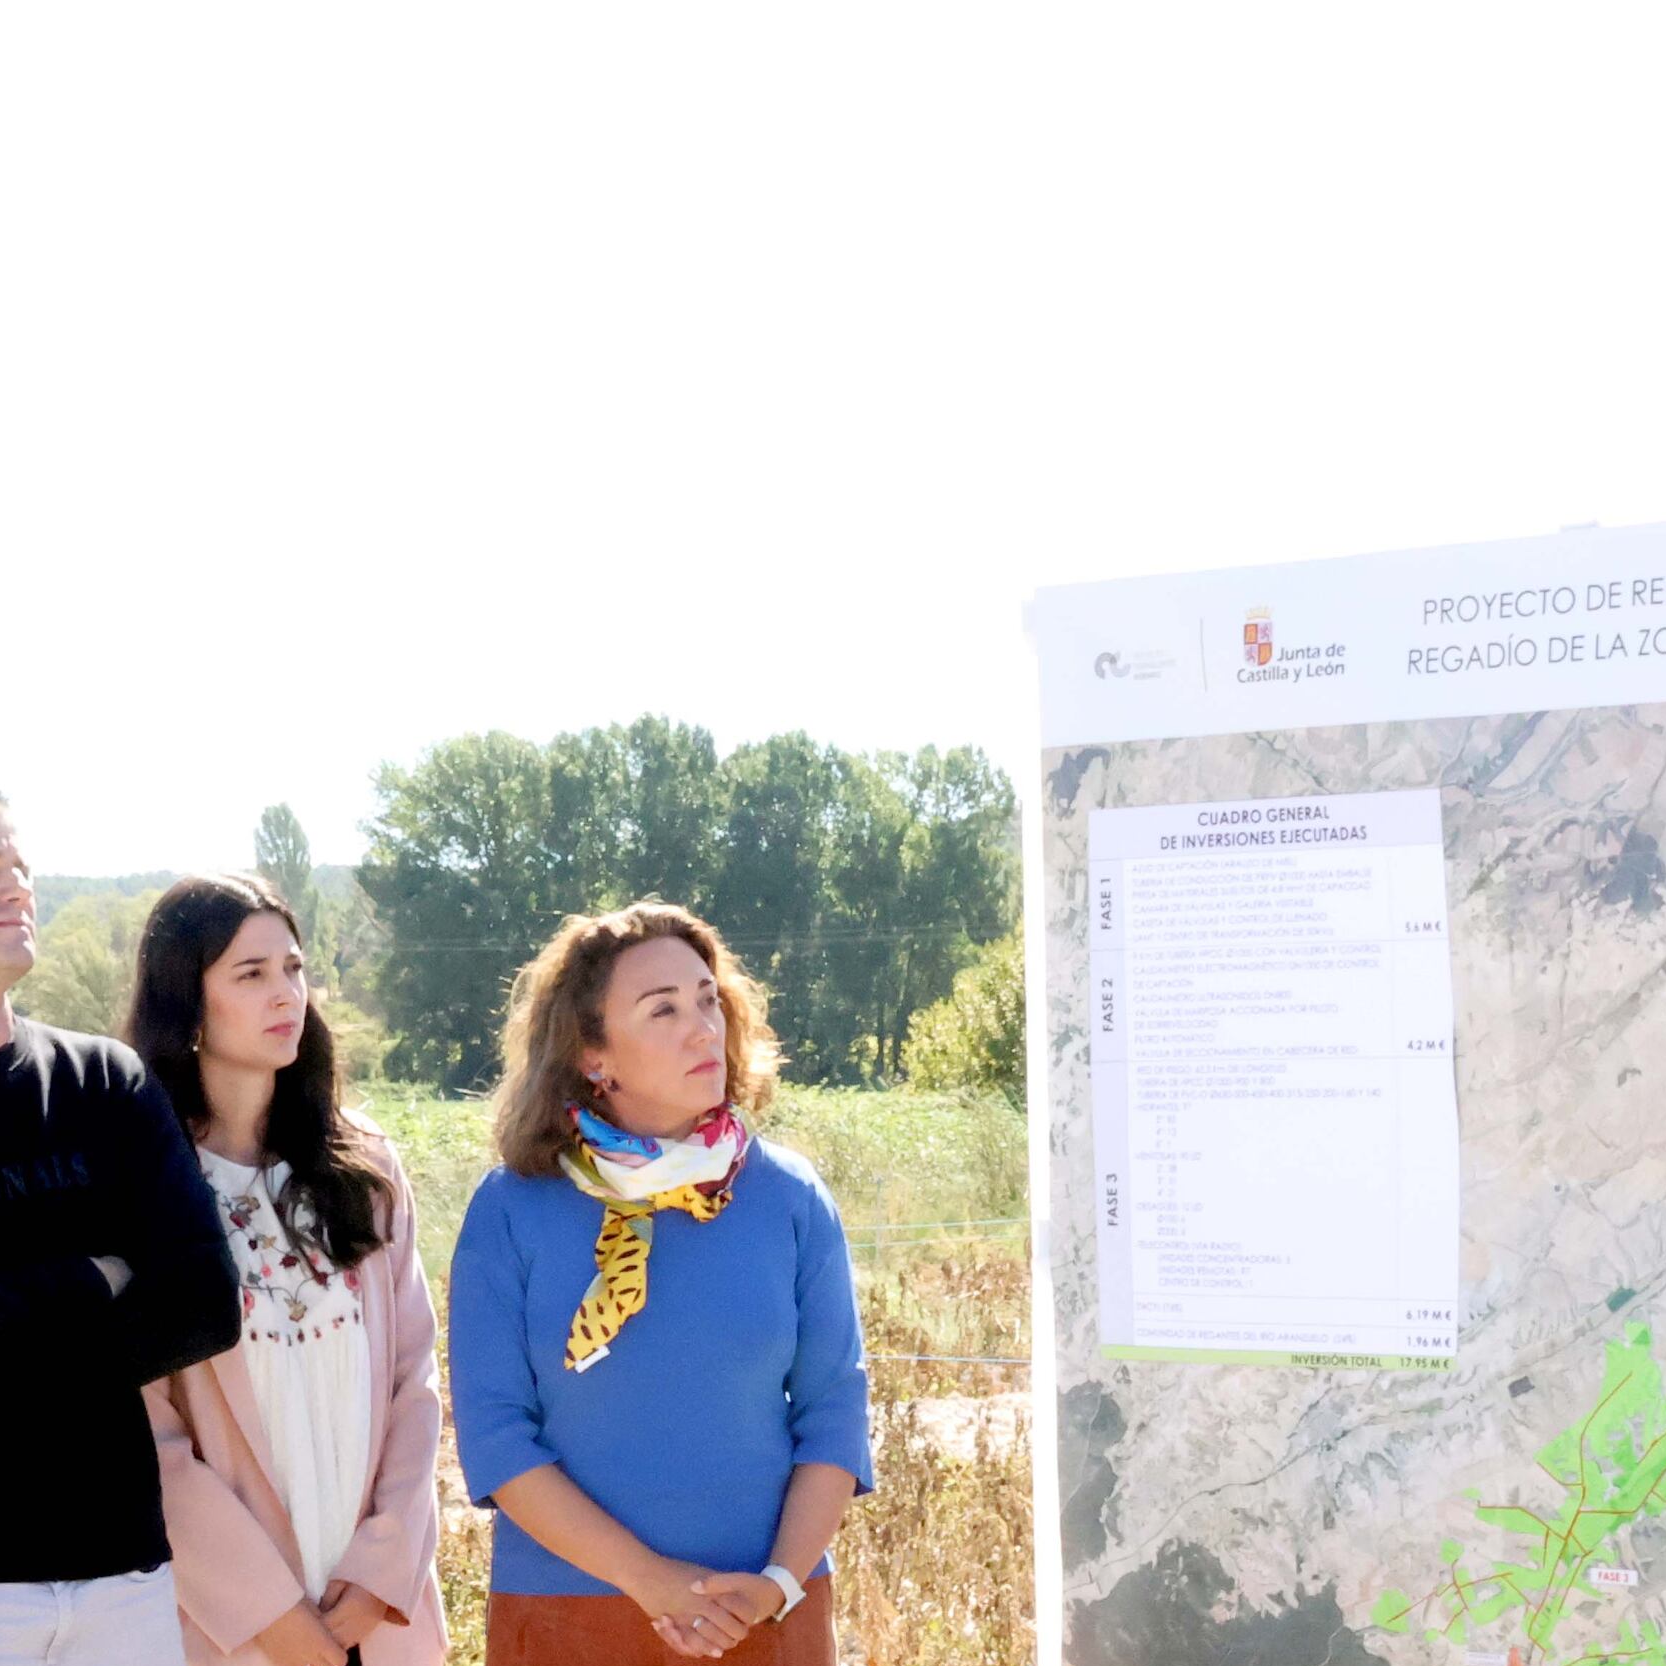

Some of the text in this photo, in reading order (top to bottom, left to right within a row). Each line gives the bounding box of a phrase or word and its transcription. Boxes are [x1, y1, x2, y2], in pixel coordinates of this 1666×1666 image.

[1424, 587, 1576, 625] PROYECTO
[1586, 582, 1621, 611] DE
[1276, 642, 1346, 663] Junta de
[1407, 634, 1537, 675] REGADÍO
[1548, 635, 1584, 663] DE
[1595, 632, 1628, 660] LA
[1236, 660, 1345, 684] Castilla y León
[1197, 805, 1330, 827] CUADRO GENERAL
[1160, 825, 1368, 850] DE INVERSIONES EJECUTADAS
[1101, 889, 1112, 930] FASE
[1422, 921, 1433, 931] M
[1434, 920, 1441, 932] €
[1102, 977, 1114, 1033] FASE 2
[1425, 1040, 1436, 1050] M
[1438, 1039, 1446, 1050] €
[1106, 1173, 1118, 1227] FASE 3
[1431, 1310, 1442, 1320] M
[1444, 1310, 1451, 1321] €
[1431, 1337, 1442, 1347] M
[1444, 1337, 1451, 1348] €
[1291, 1353, 1347, 1367] INVERSIÓN
[1350, 1355, 1382, 1367] TOTAL
[1430, 1359, 1440, 1368] M
[1443, 1359, 1450, 1369] €
[1598, 1571, 1621, 1582] FASE
